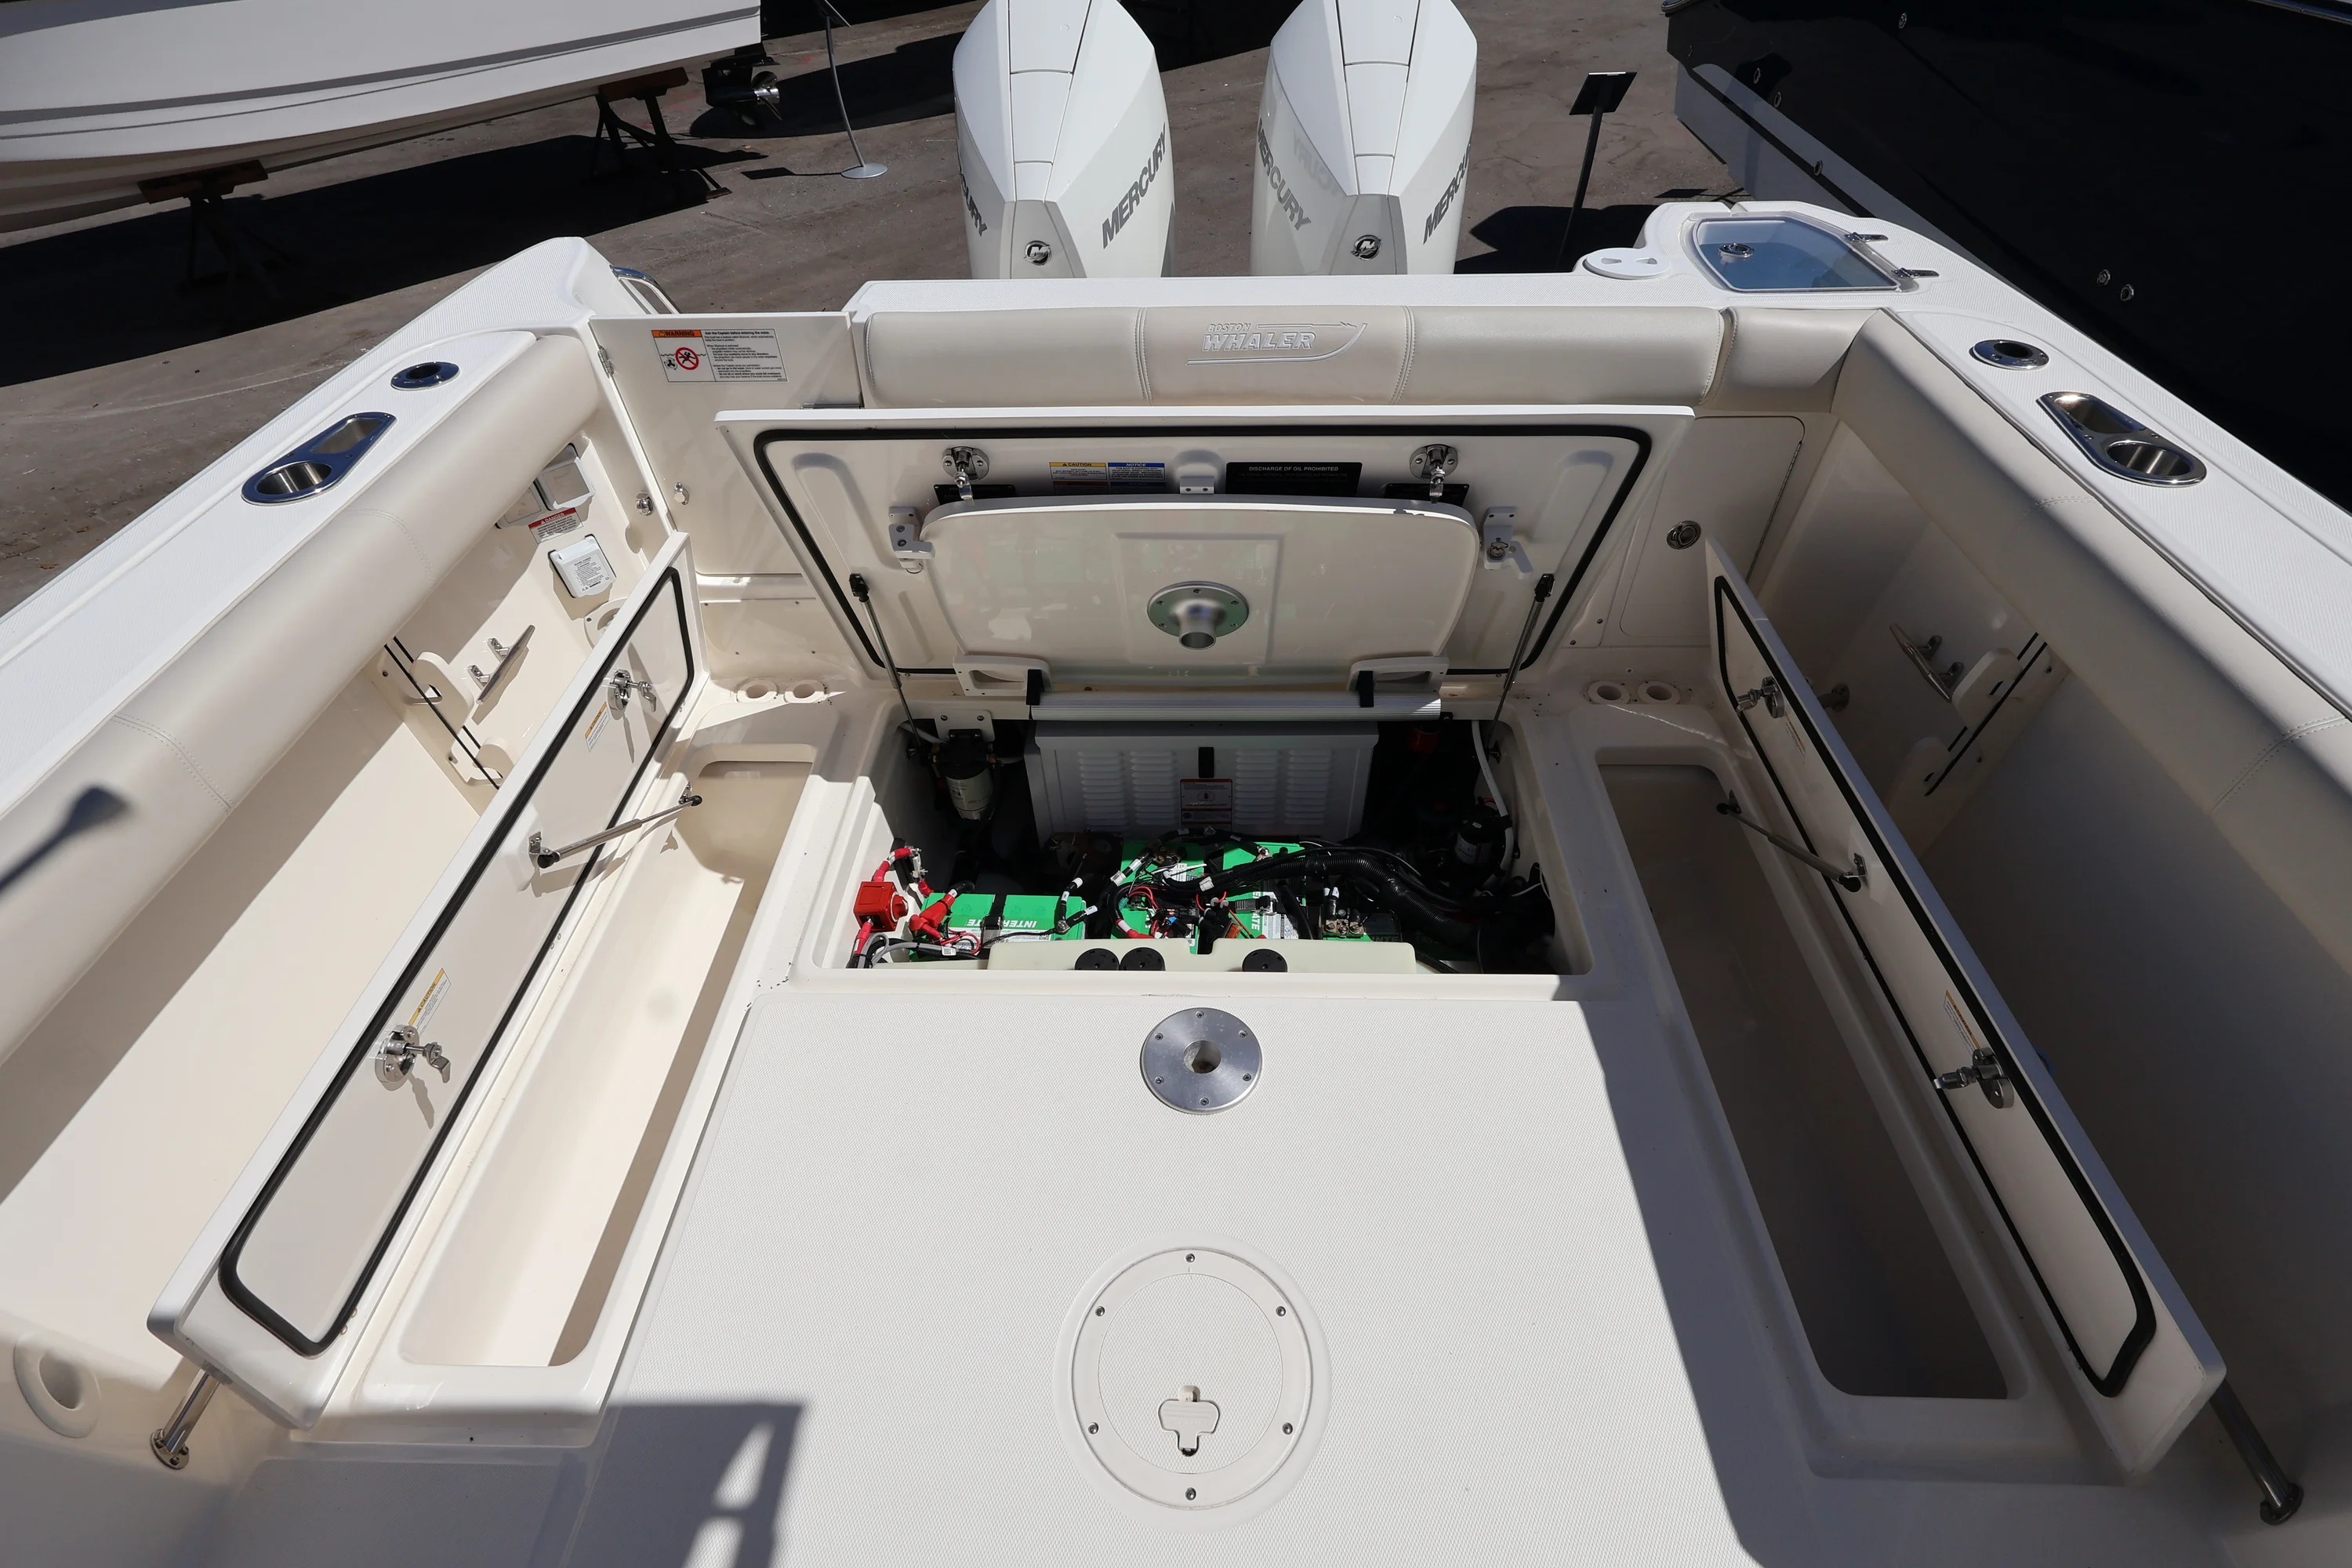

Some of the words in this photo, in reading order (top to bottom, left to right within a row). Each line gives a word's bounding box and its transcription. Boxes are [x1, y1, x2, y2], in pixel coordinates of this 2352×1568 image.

[1102, 122, 1166, 249] MERCURY
[1258, 118, 1312, 230] MERCURY
[1202, 332, 1316, 351] WHALER
[1208, 323, 1251, 332] BOSTON
